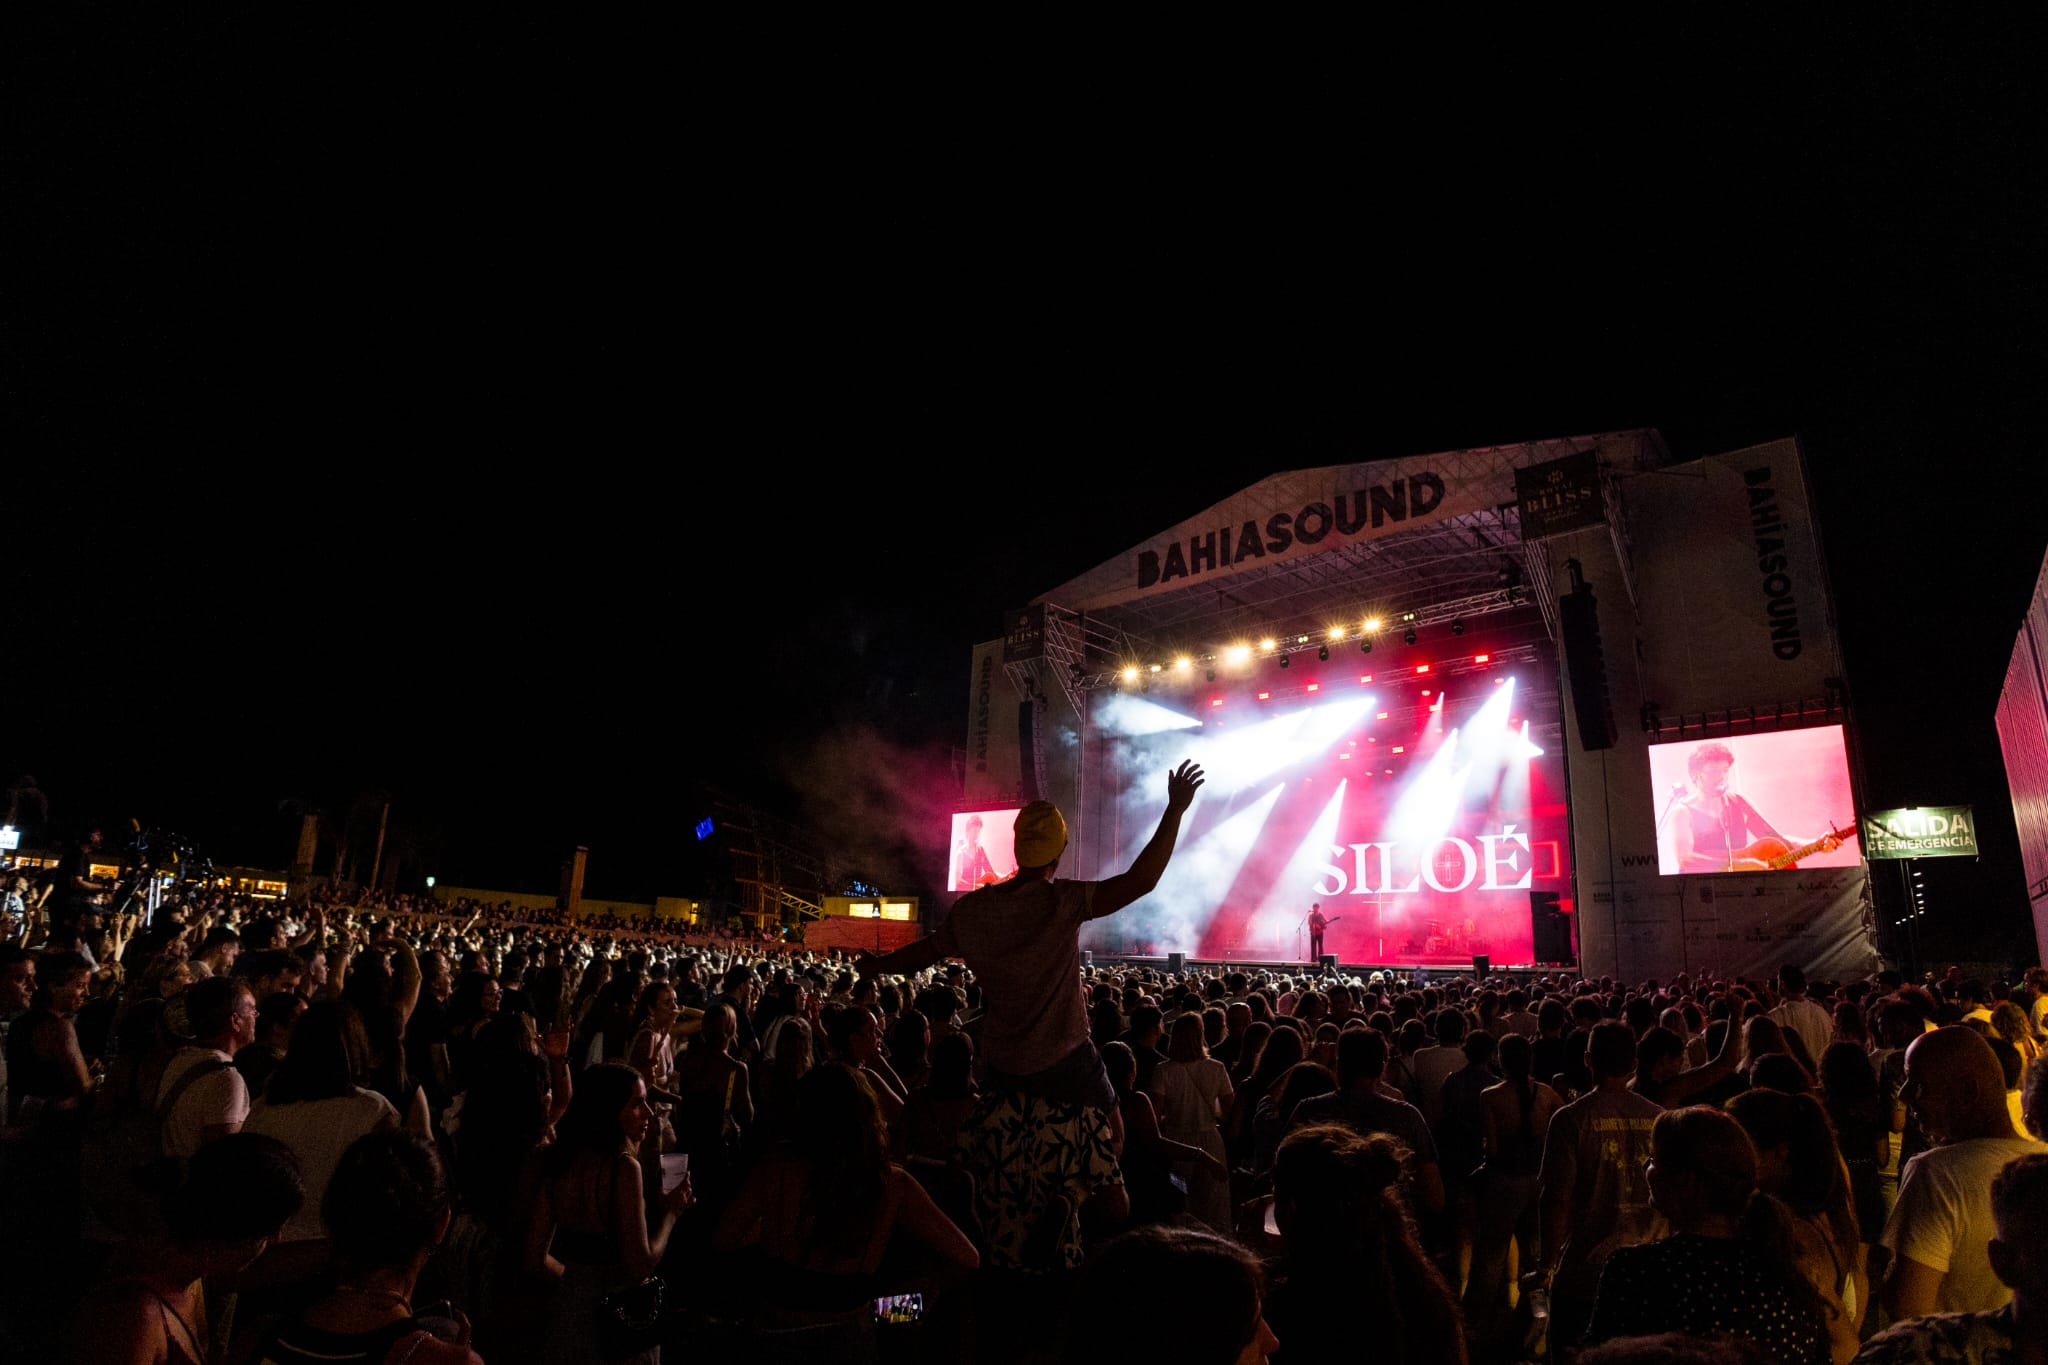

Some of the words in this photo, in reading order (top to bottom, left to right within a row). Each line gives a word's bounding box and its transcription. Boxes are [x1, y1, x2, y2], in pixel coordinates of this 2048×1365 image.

[1137, 471, 1445, 589] BAHIASOUND
[1867, 814, 1969, 839] SALIDA
[1888, 836, 1974, 850] EMERGENCIA
[1312, 824, 1532, 896] SILOÉ
